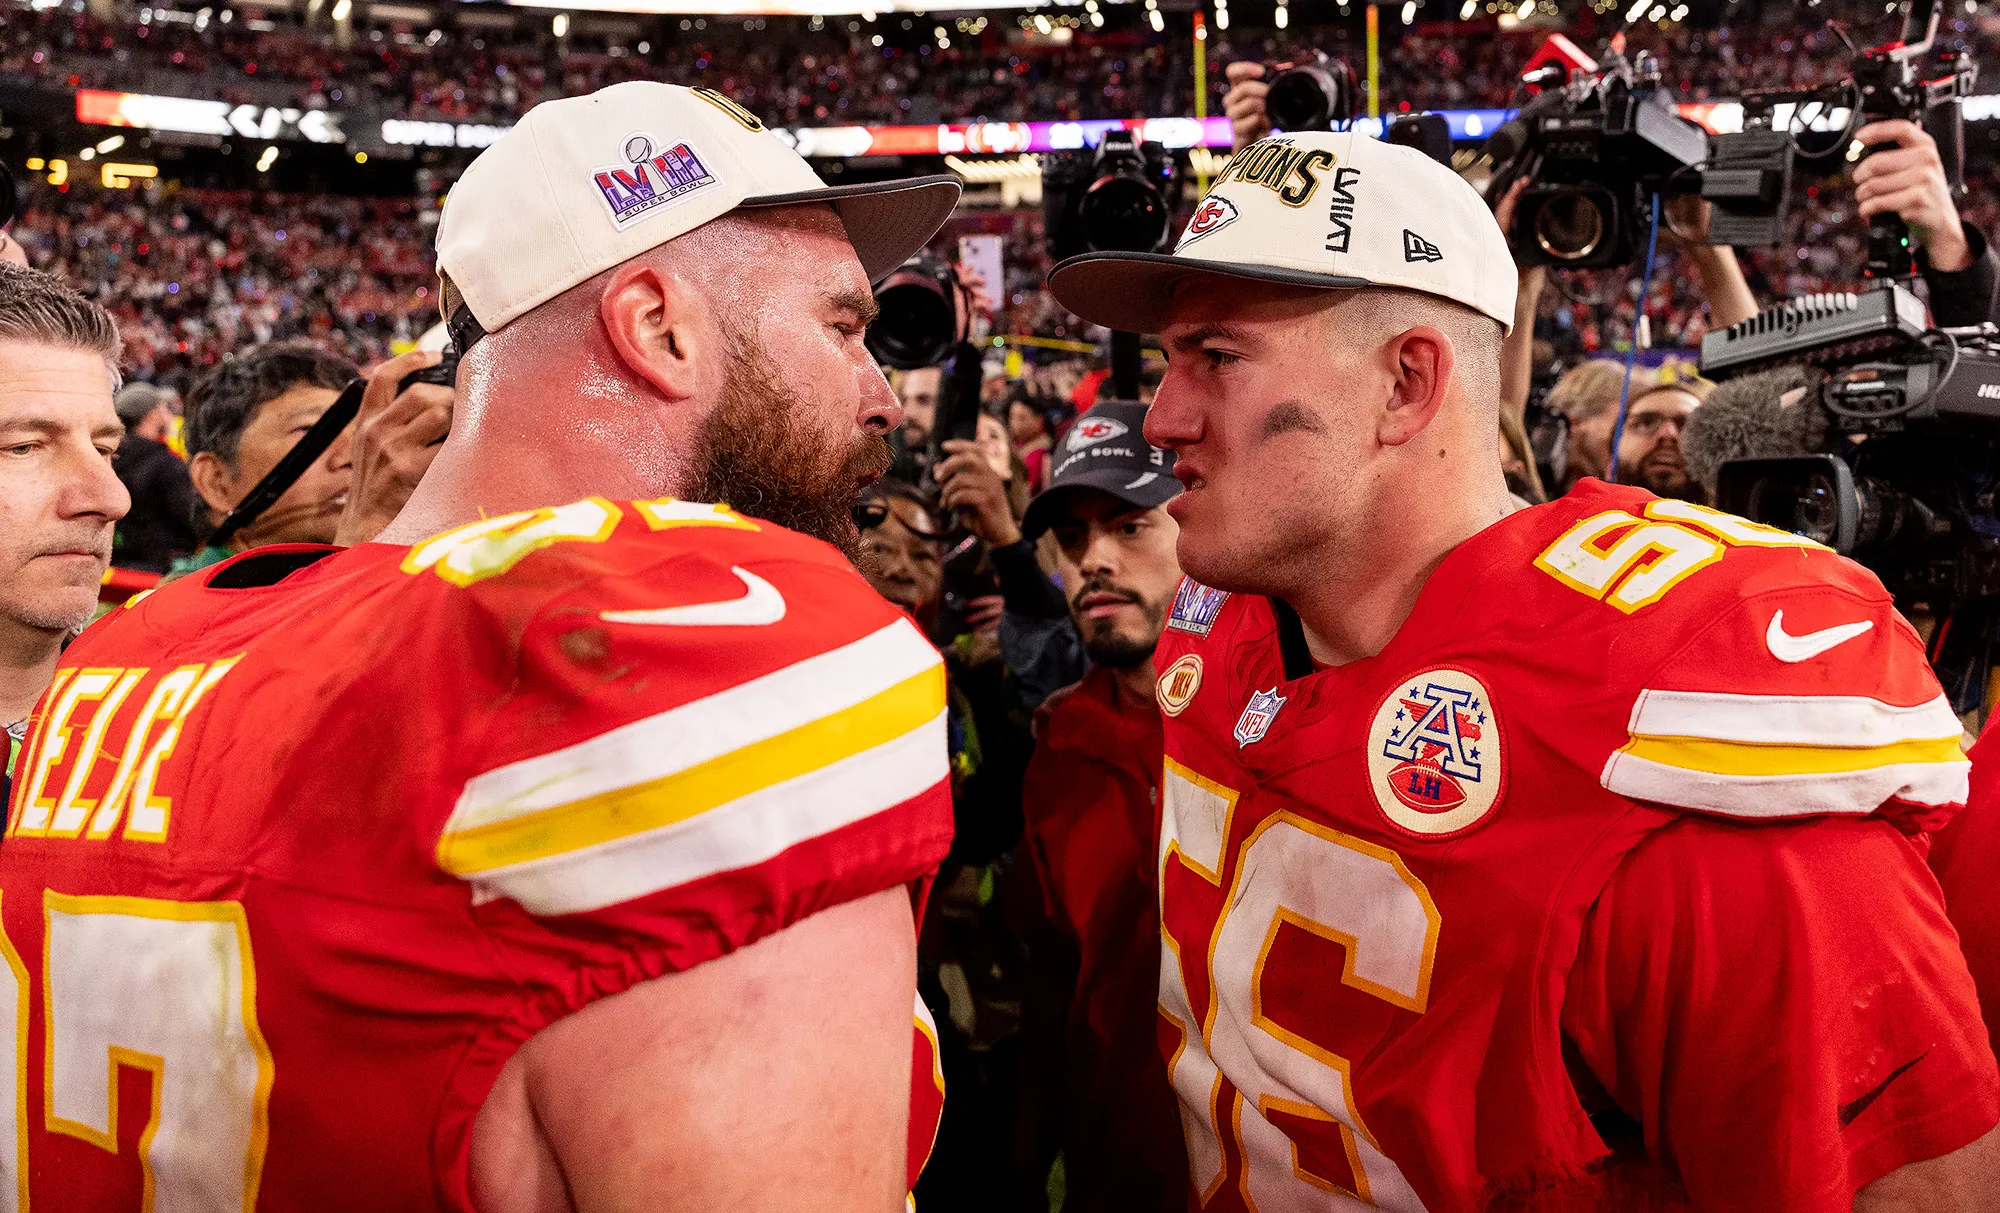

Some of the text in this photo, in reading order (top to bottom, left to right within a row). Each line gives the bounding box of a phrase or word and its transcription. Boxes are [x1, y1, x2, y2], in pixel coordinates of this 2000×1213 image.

[624, 181, 705, 217] SUPER BOWL
[1209, 142, 1337, 209] PIONS
[1091, 447, 1135, 457] BOWL
[5, 652, 247, 842] ELCE
[1240, 712, 1266, 736] NFL
[1383, 683, 1481, 783] A
[1408, 773, 1442, 800] LH
[0, 887, 275, 1213] 7
